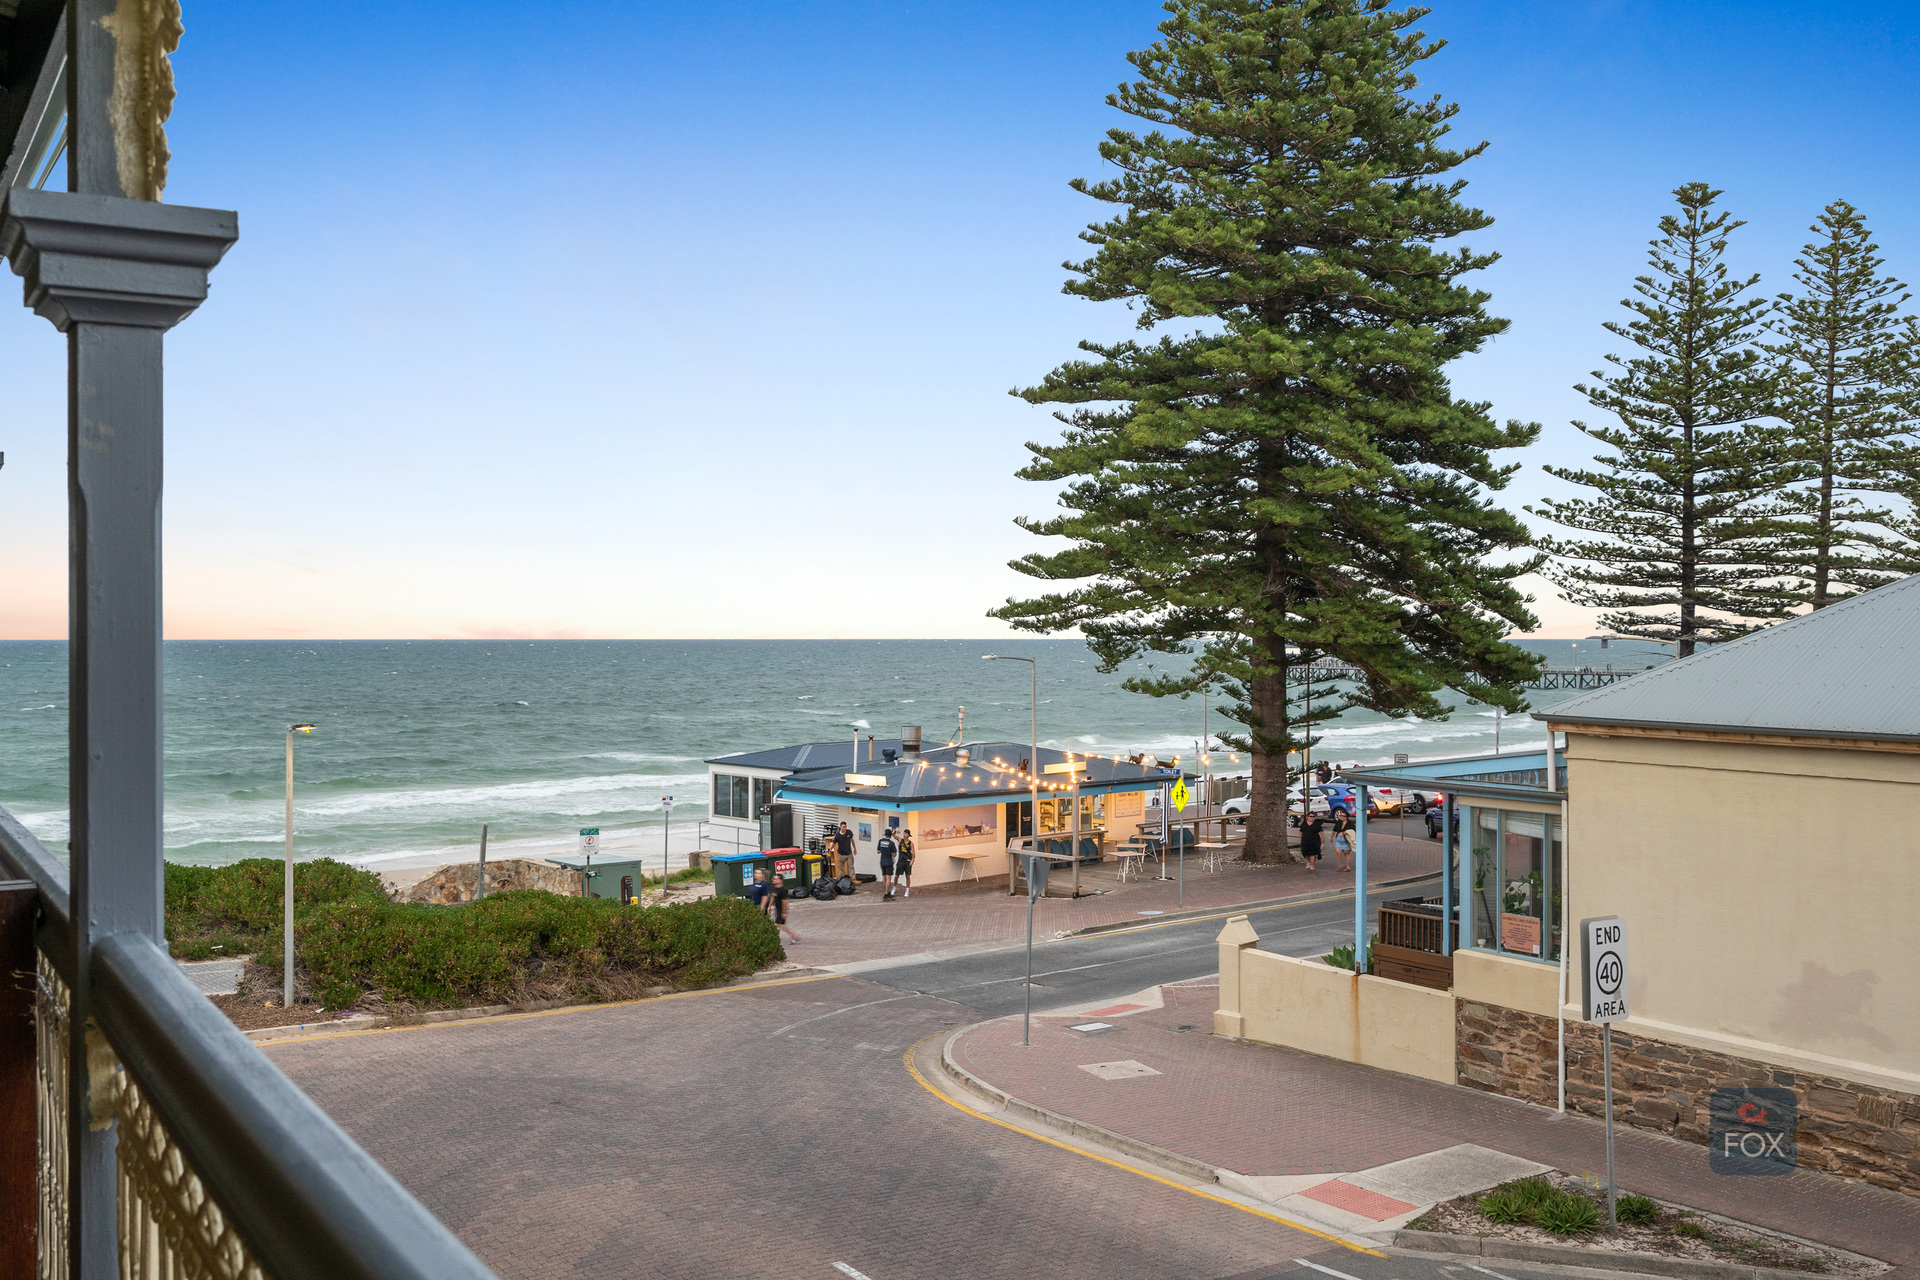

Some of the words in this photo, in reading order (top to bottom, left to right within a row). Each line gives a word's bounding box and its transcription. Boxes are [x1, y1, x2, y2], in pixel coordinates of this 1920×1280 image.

[1596, 926, 1620, 945] END
[1600, 961, 1619, 984] 40
[1595, 1000, 1625, 1018] AREA
